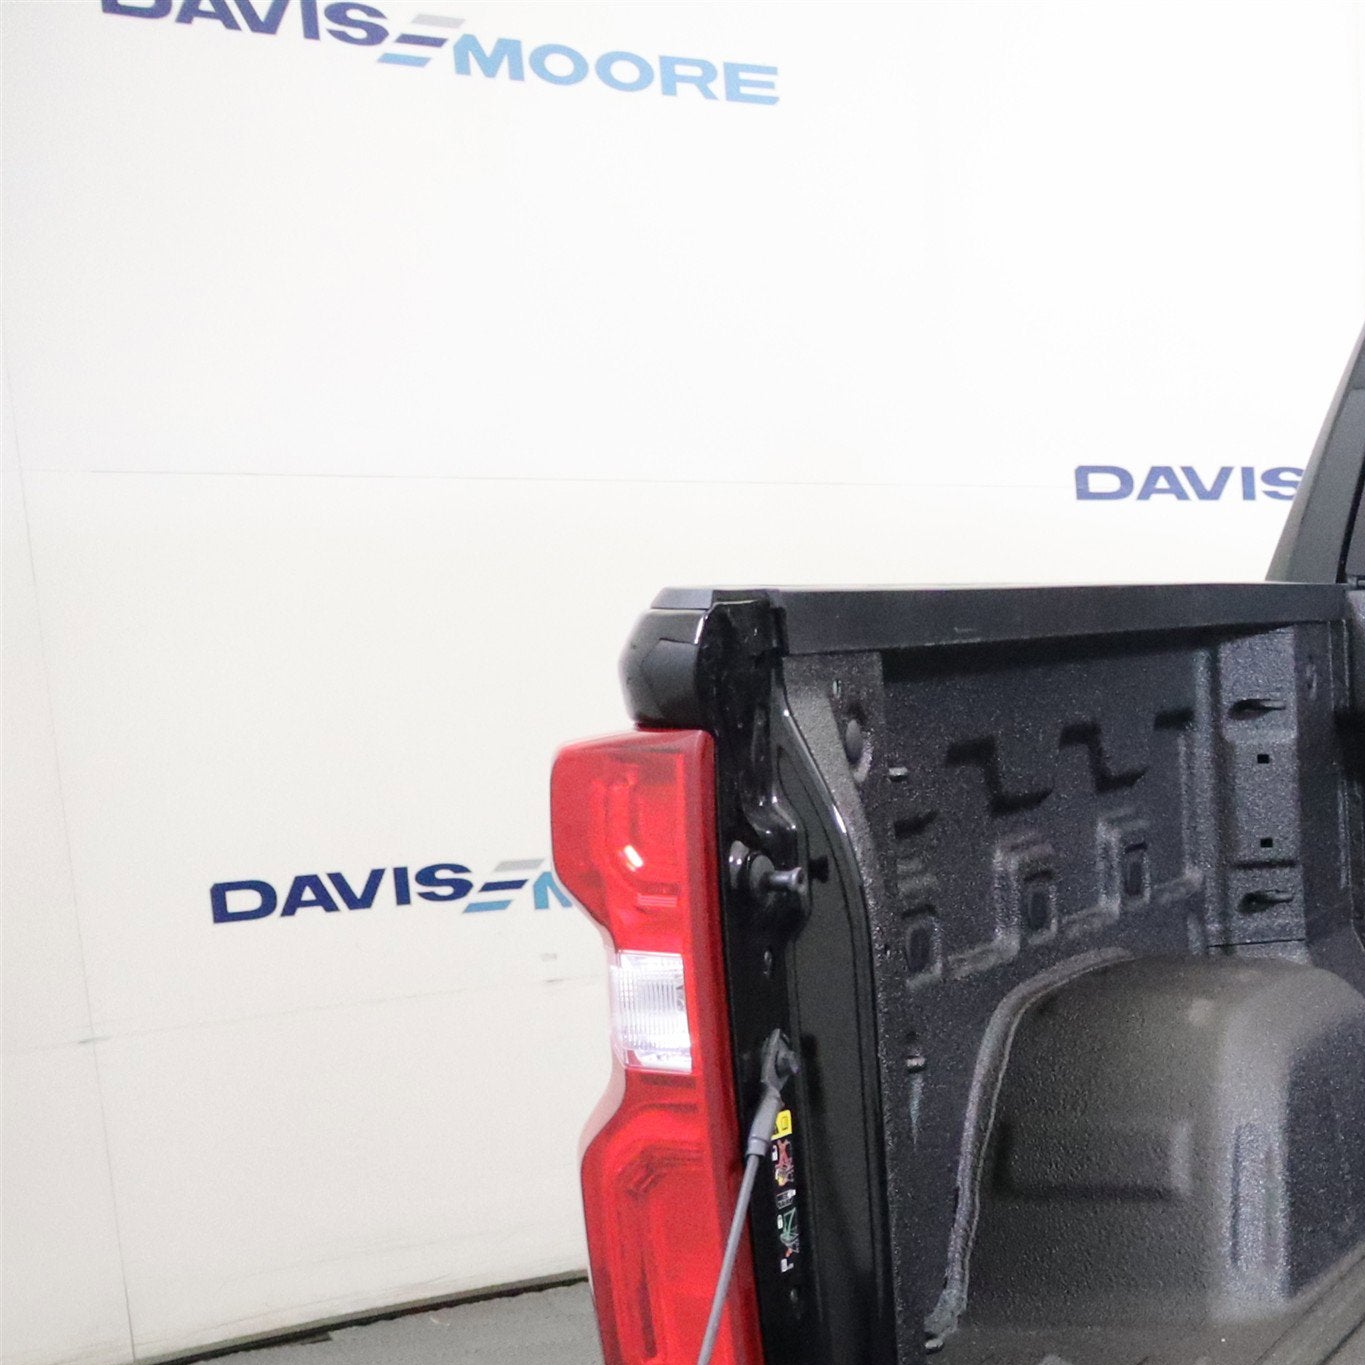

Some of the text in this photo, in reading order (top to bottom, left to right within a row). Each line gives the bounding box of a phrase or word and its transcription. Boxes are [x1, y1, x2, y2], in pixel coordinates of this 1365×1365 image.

[453, 33, 780, 106] MOORE
[1074, 465, 1304, 501] DAVIS
[210, 863, 474, 924] DAVIS
